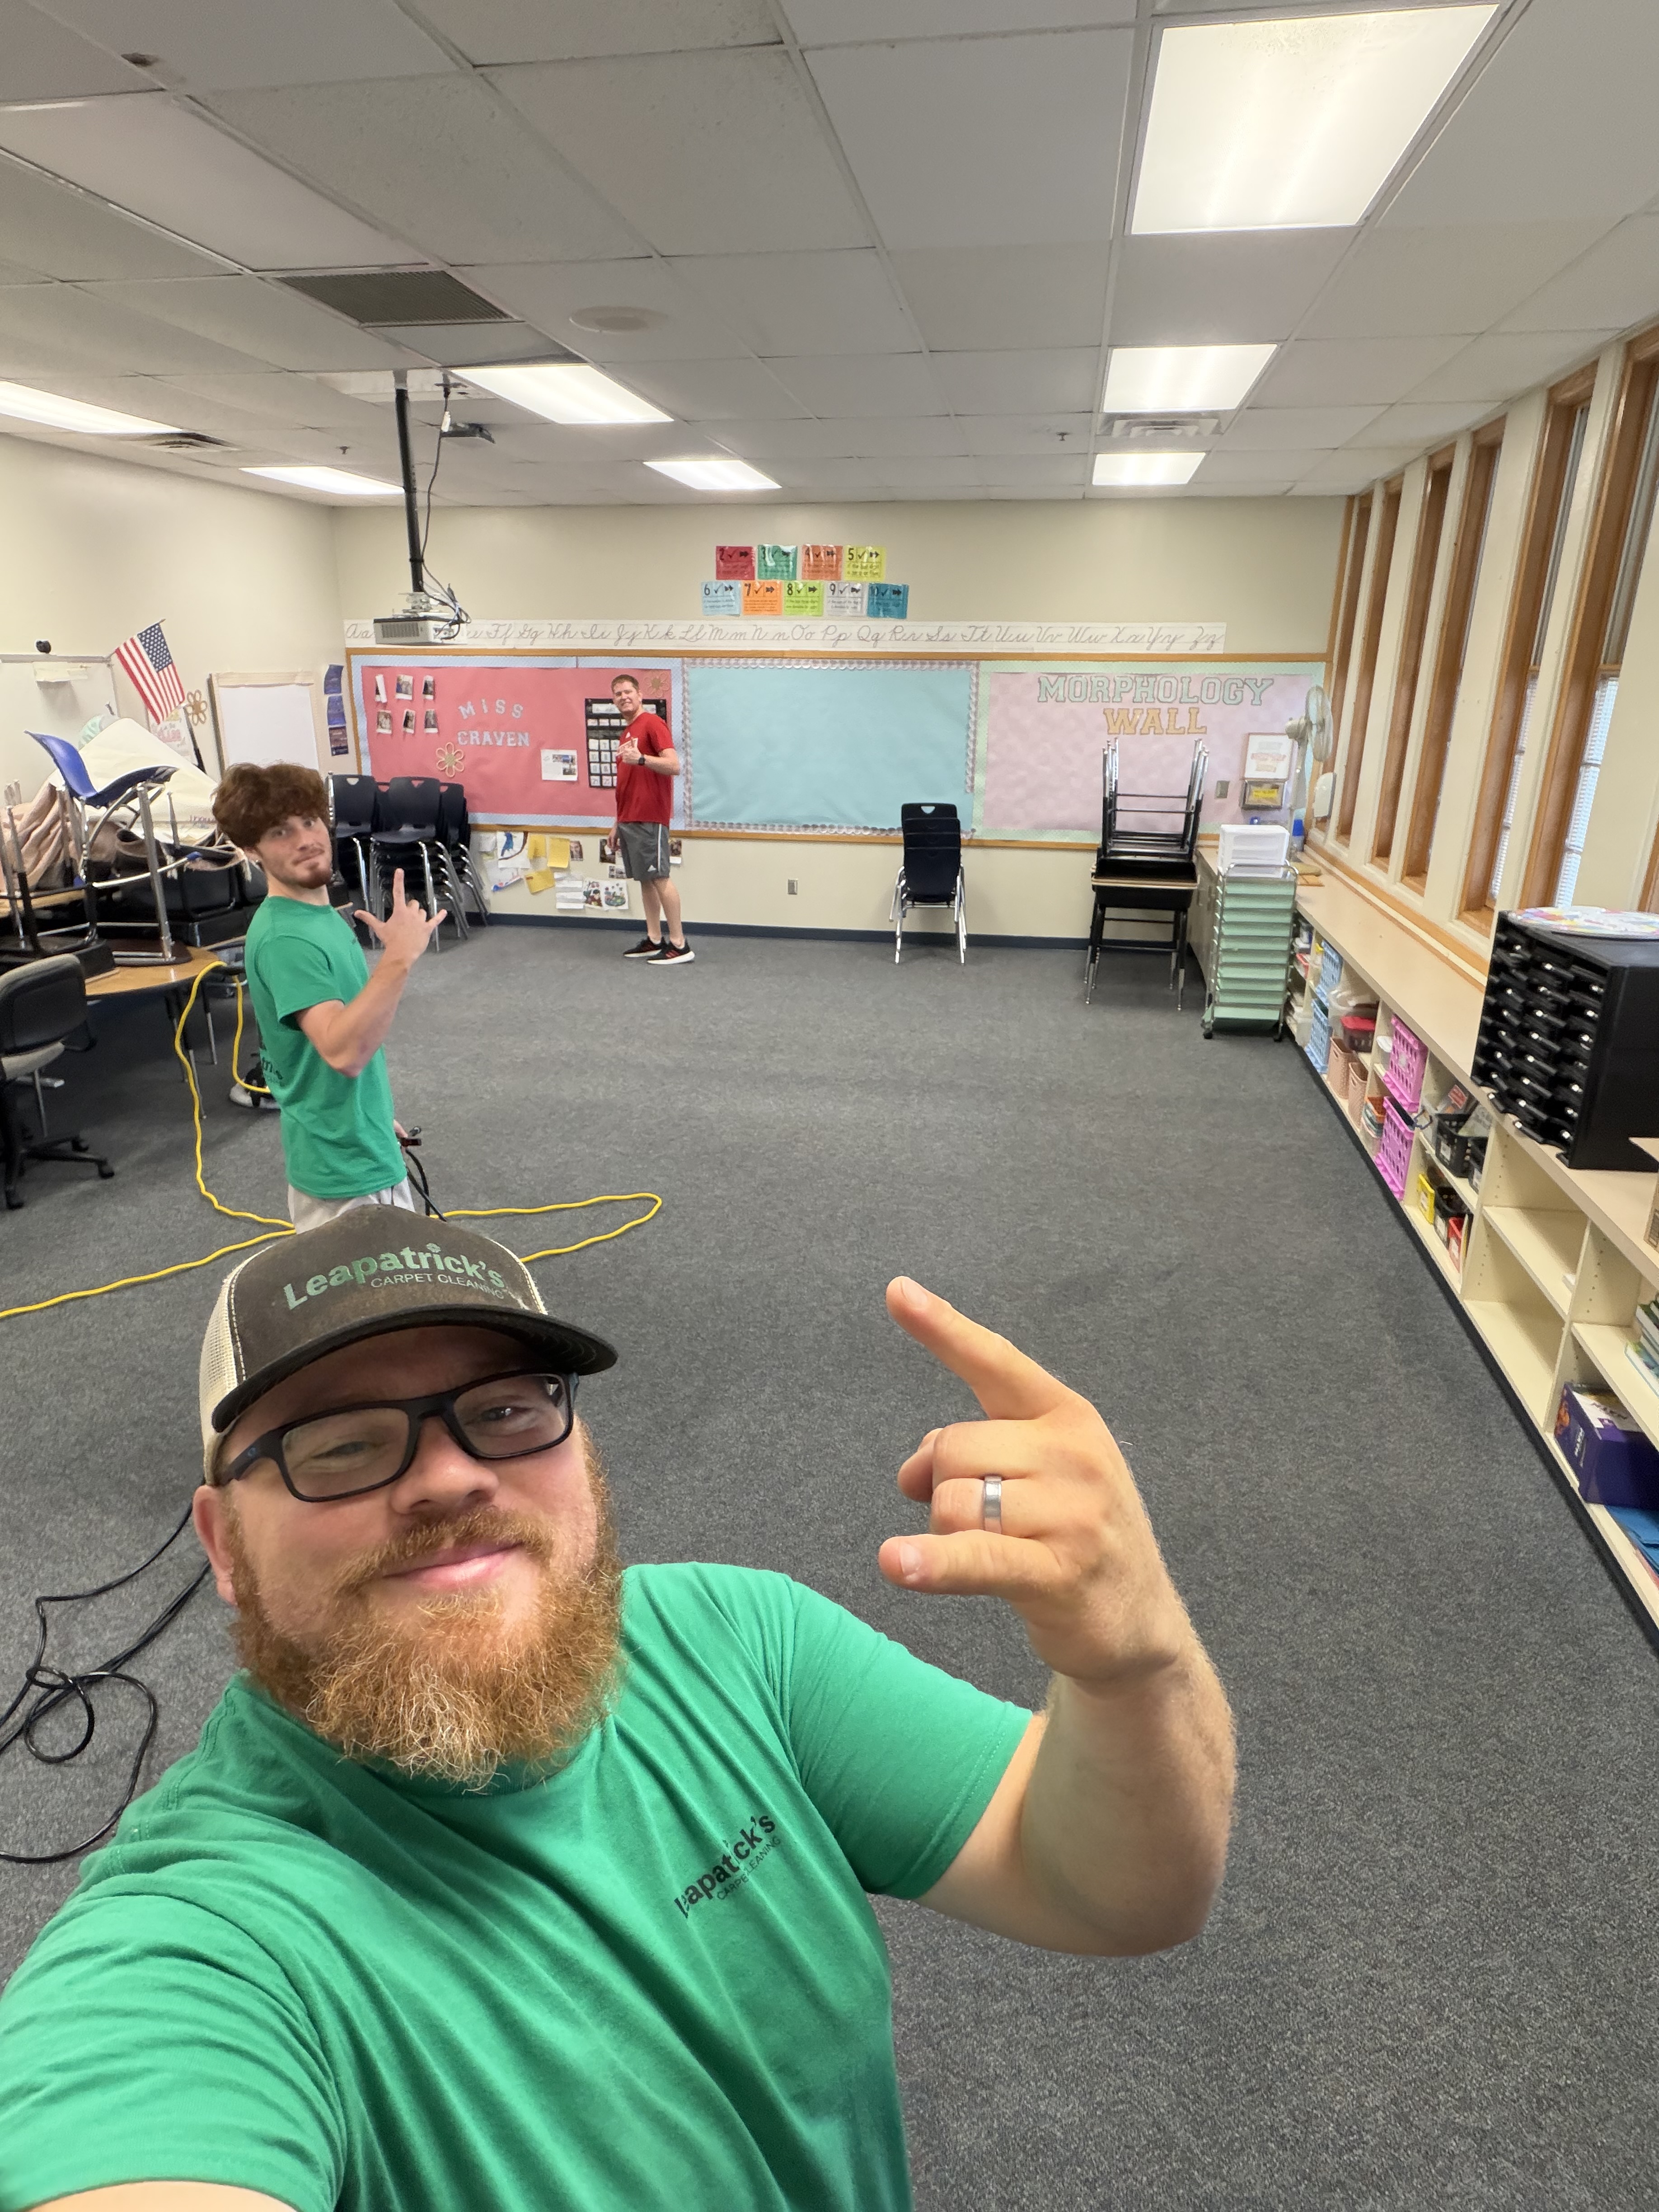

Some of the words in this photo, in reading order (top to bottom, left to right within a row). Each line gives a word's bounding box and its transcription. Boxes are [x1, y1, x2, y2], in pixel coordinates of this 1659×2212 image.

[848, 548, 854, 560] 5
[704, 583, 710, 595] 6
[744, 583, 751, 596] 7
[787, 583, 793, 595] 8
[830, 583, 836, 595] 9
[1037, 675, 1274, 706] MORPHOLOGY
[458, 698, 524, 719] MISS
[1103, 707, 1207, 735] WALL
[457, 730, 530, 746] CRAVEN
[283, 1243, 505, 1310] Leapatrick's
[371, 1274, 432, 1288] CARPET
[437, 1274, 505, 1299] CLEANING
